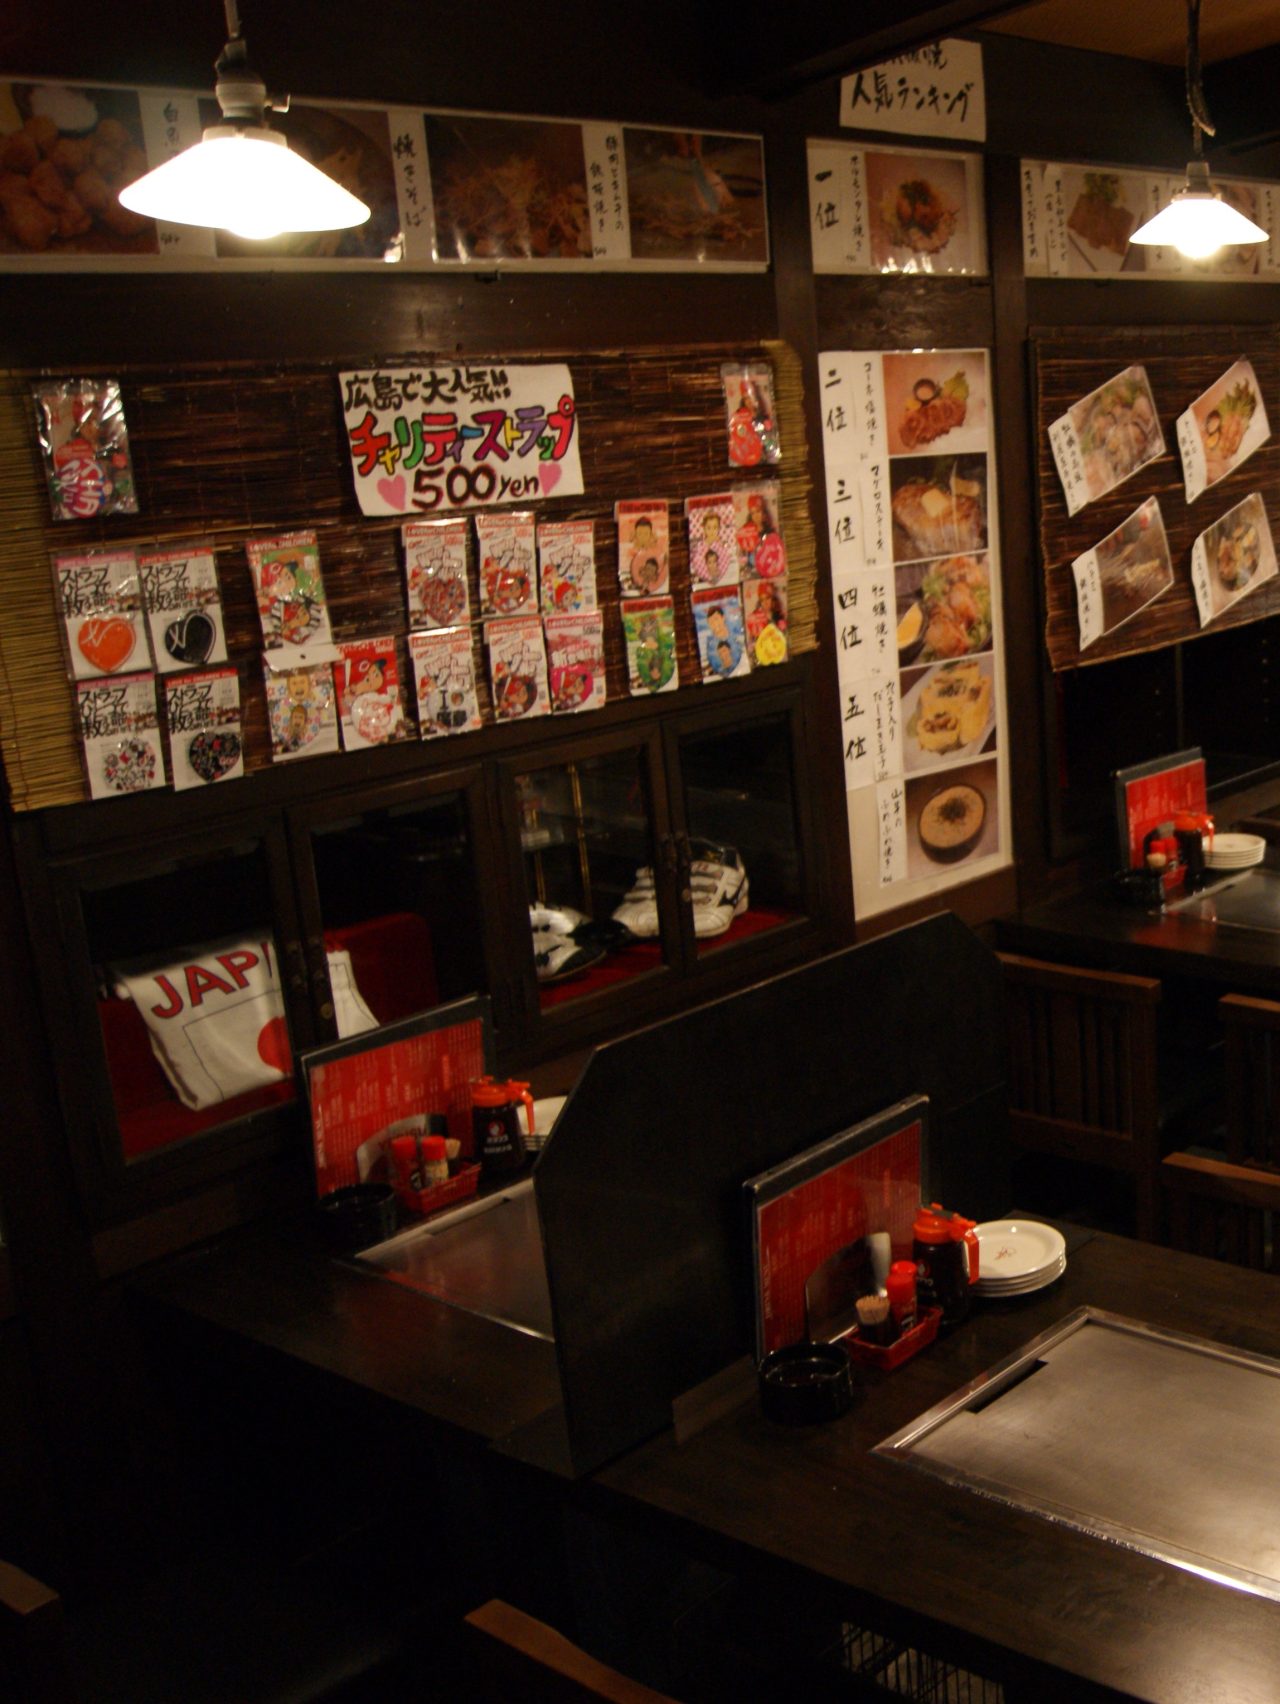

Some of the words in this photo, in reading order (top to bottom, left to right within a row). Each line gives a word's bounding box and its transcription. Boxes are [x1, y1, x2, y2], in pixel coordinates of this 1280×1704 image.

[851, 70, 975, 123] 人気ランキング
[393, 133, 427, 227] 焼きそば
[815, 170, 839, 231] 一位
[825, 368, 848, 432] 二位
[349, 394, 577, 477] チャリティーストラップ
[411, 463, 496, 510] 500
[496, 474, 540, 500] yen
[833, 479, 856, 545] 三位
[838, 586, 863, 651] 四位
[844, 694, 867, 761] 五位
[151, 942, 273, 1019] JAP
